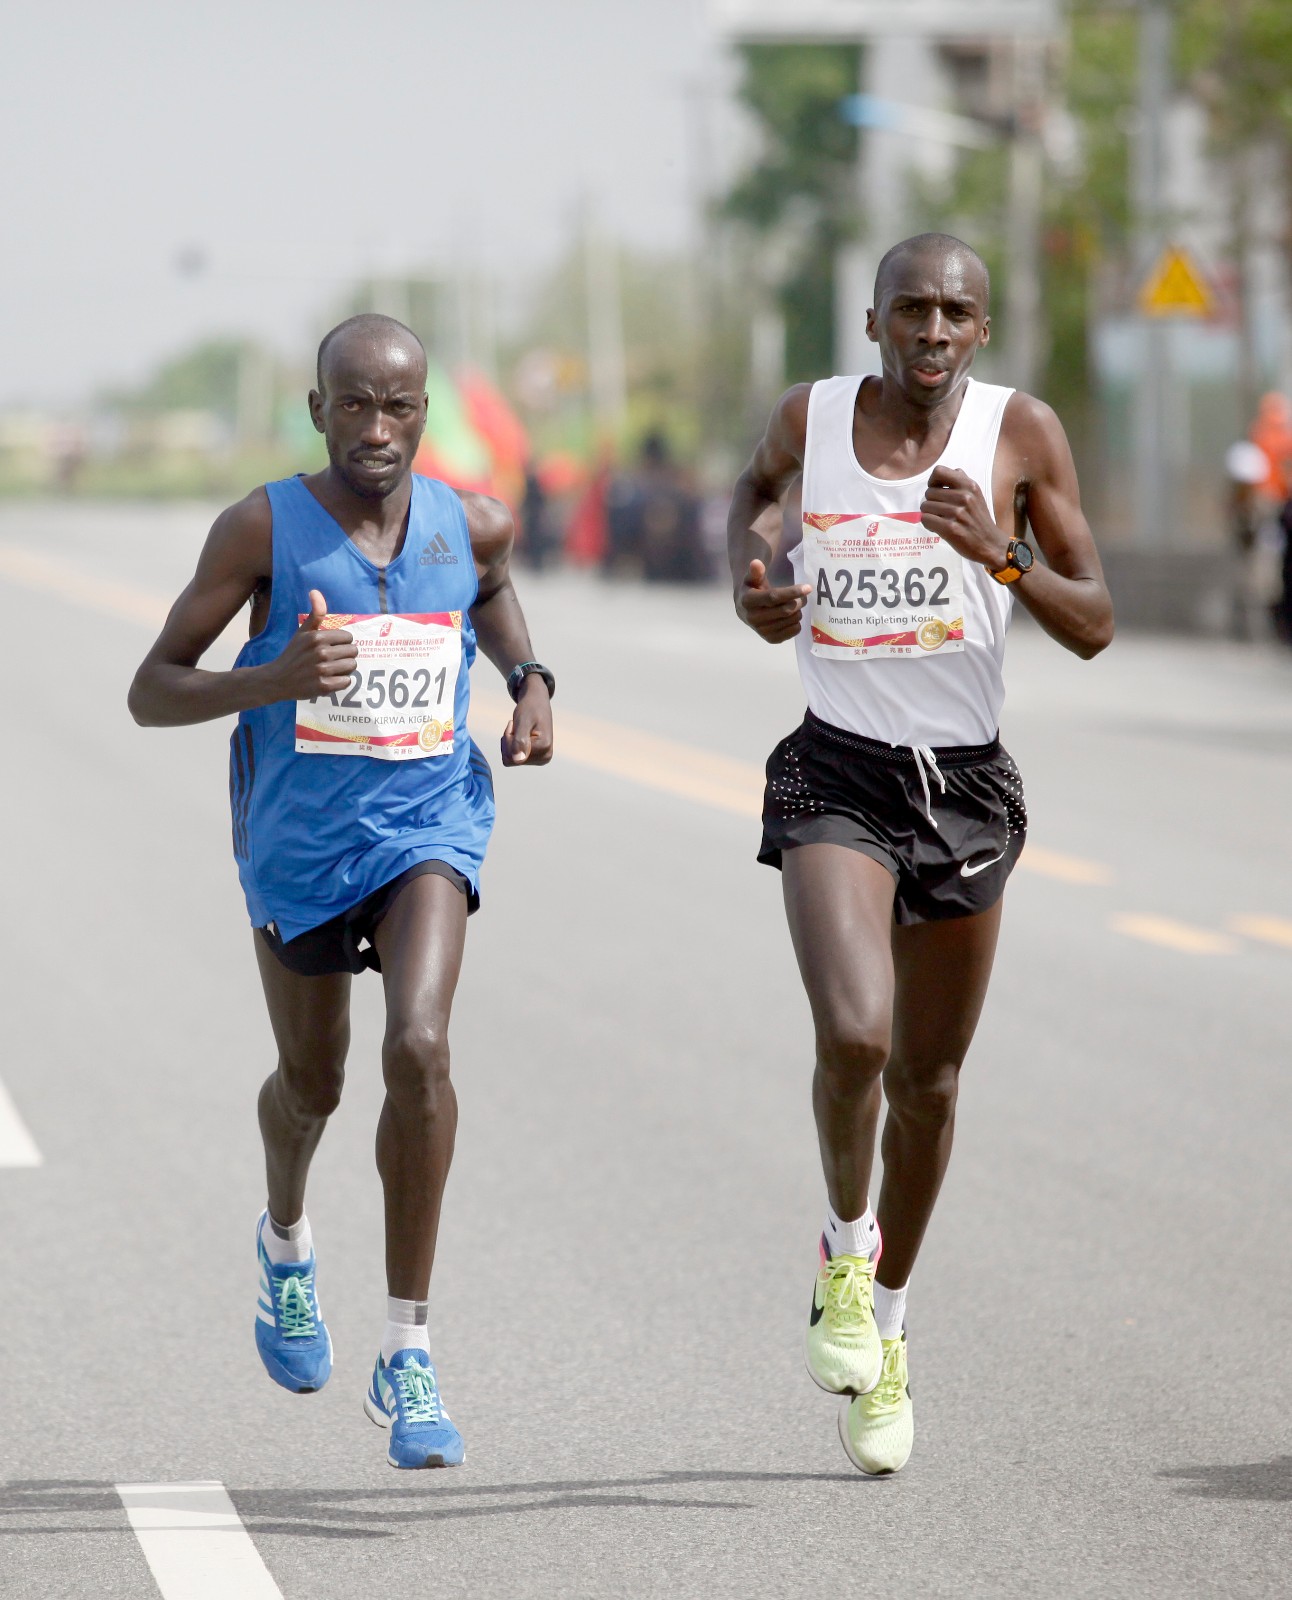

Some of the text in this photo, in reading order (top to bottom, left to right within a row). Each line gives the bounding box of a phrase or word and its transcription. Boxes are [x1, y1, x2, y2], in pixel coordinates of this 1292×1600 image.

[842, 539, 861, 547] 2018
[419, 553, 459, 566] adidas
[816, 566, 950, 609] A25362
[828, 615, 863, 625] Jonathan
[866, 615, 908, 626] Kipleting
[354, 639, 374, 647] 2018
[309, 666, 447, 709] 25621
[328, 713, 433, 725] WILFRED KIRWA KIGEN
